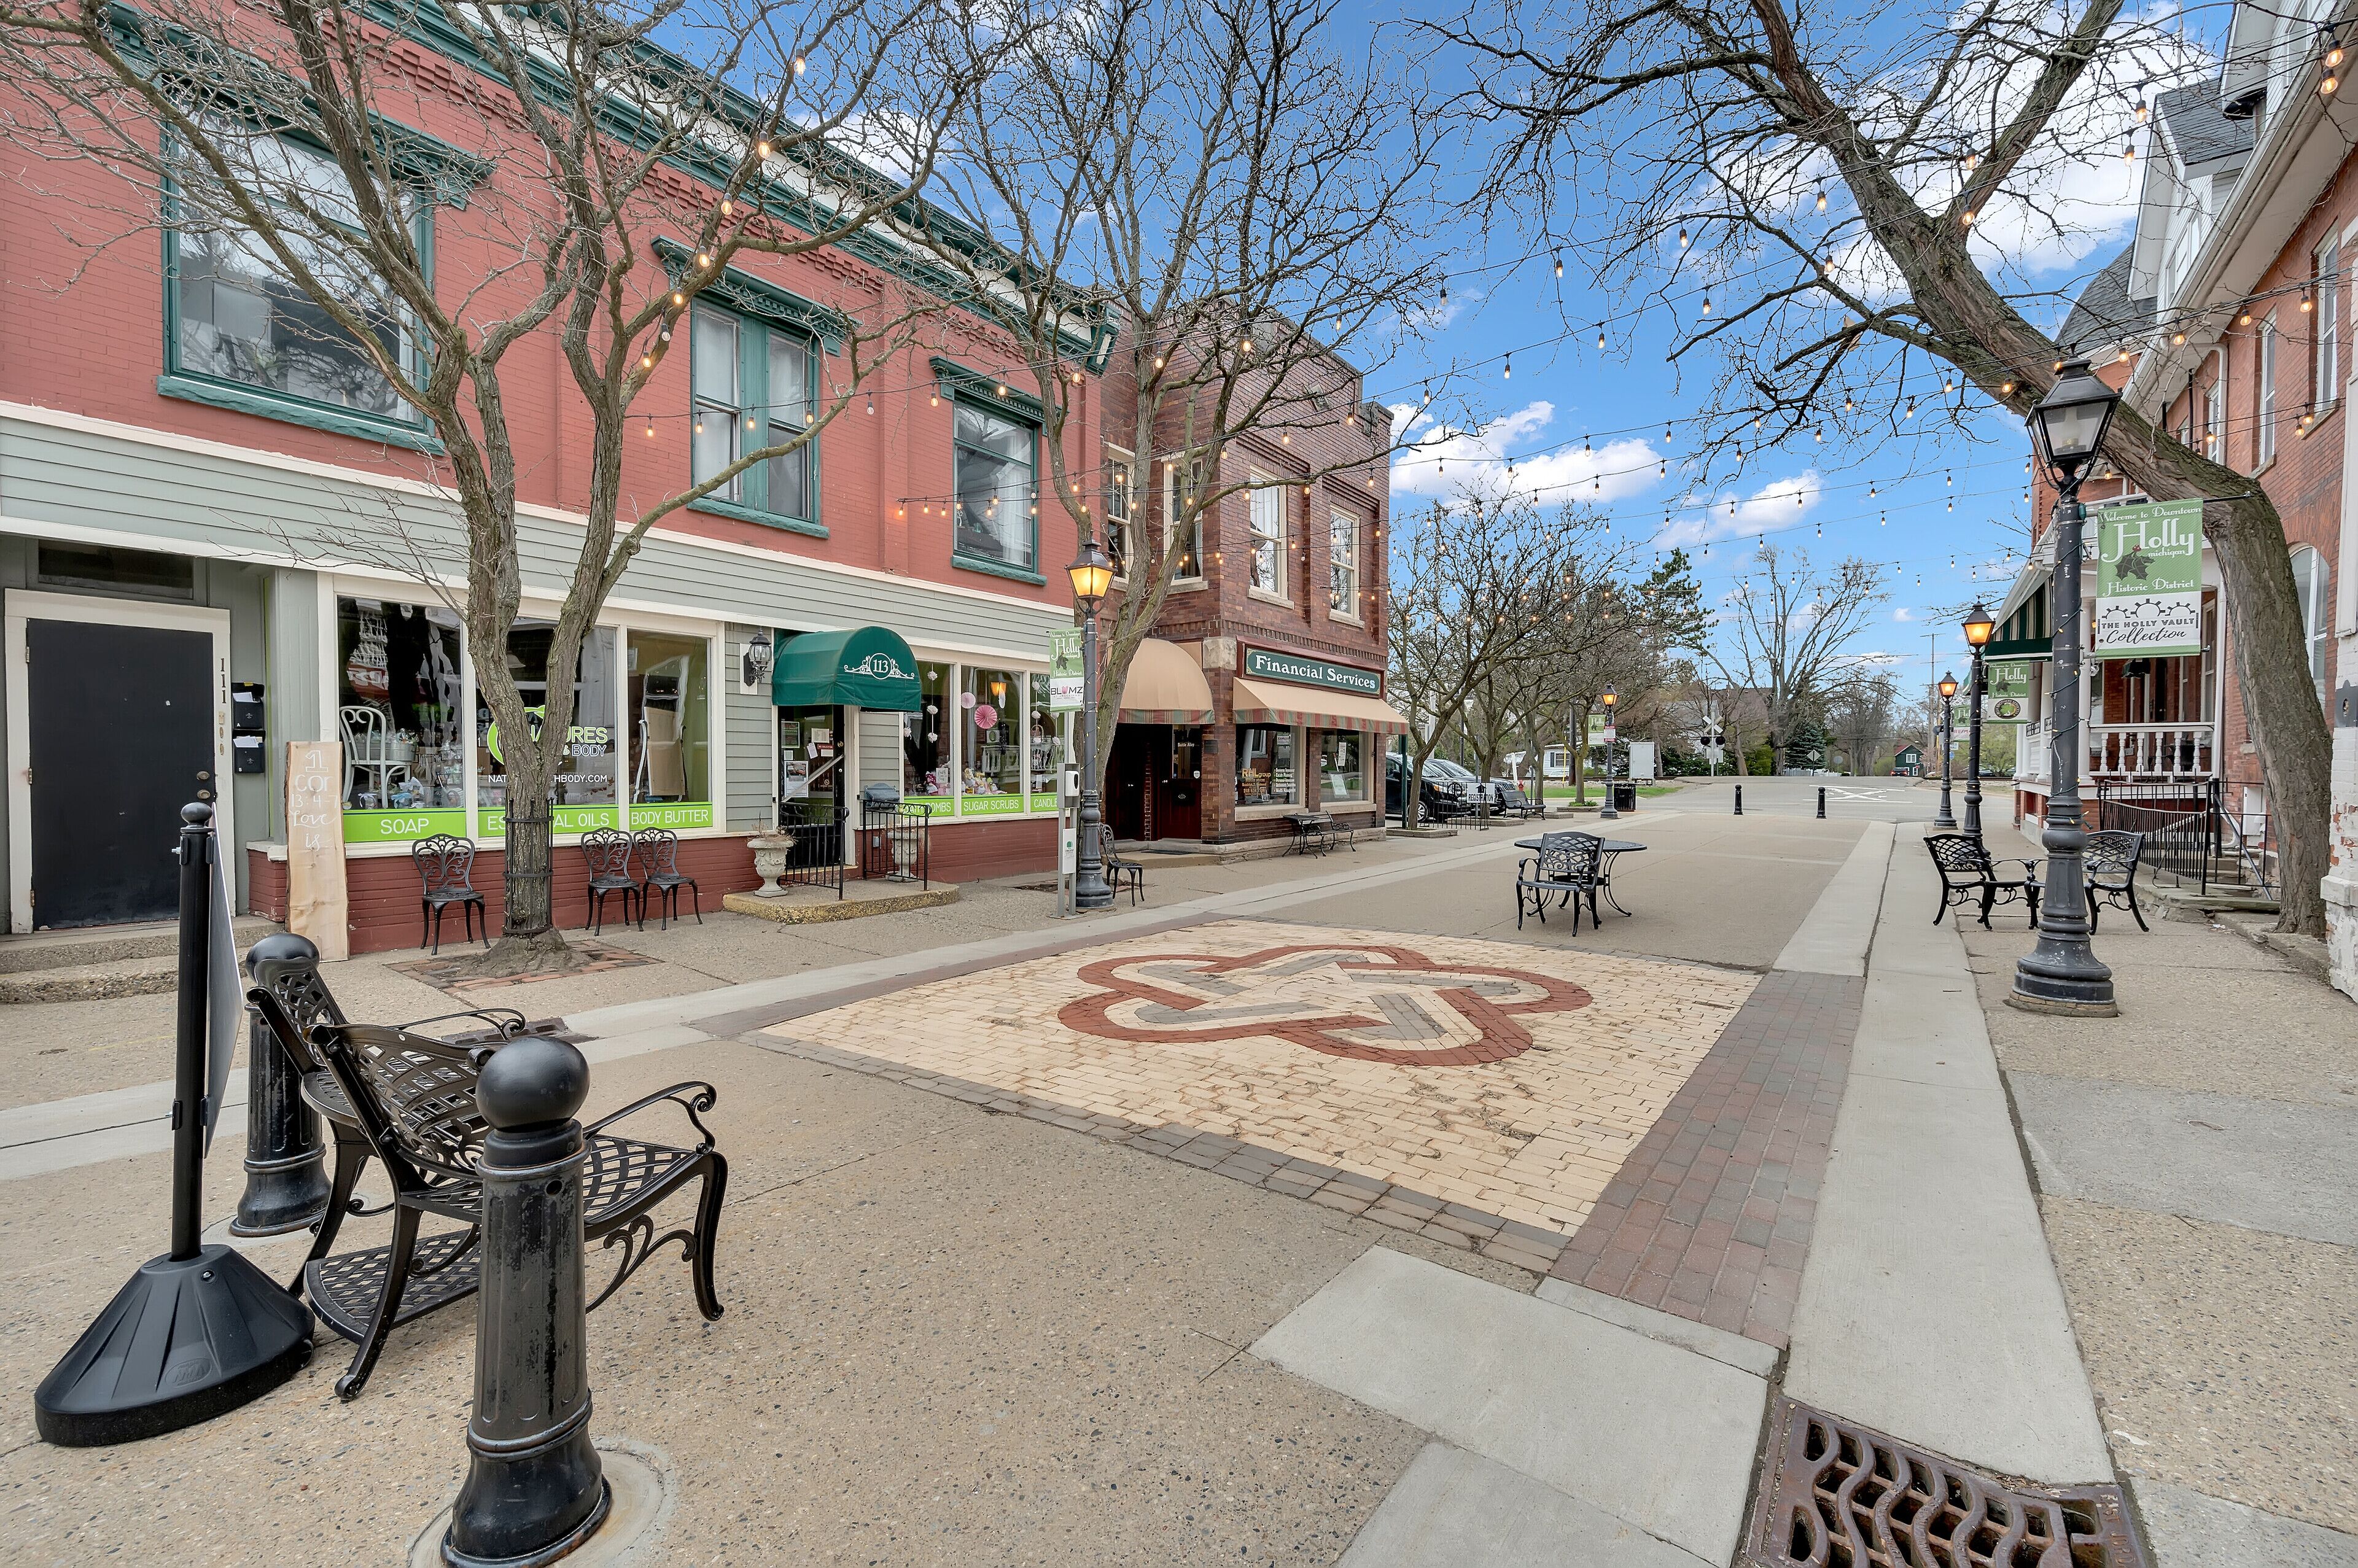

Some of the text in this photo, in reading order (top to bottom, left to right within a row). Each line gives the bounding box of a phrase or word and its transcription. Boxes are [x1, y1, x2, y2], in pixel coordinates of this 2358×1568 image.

[2098, 512, 2137, 522] Welcome
[2152, 506, 2202, 518] Downtown
[2101, 518, 2195, 563] Holly
[2148, 548, 2186, 558] michigan
[2102, 577, 2194, 597] Historic District
[2162, 618, 2195, 626] VAULT
[2106, 627, 2187, 645] Collection
[1051, 637, 1081, 661] Holly
[873, 659, 889, 673] 113
[1255, 654, 1376, 689] Financial Services
[1990, 667, 2026, 685] Holly
[572, 744, 607, 757] BODY
[305, 750, 329, 772] 1
[963, 799, 1019, 812] SUGAR SCRUBS
[1033, 798, 1057, 808] CANDLE
[289, 809, 338, 828] Love
[578, 812, 610, 827] OILS
[631, 809, 709, 825] BODY BUTTER
[380, 818, 430, 836] SOAP
[305, 833, 332, 852] is
